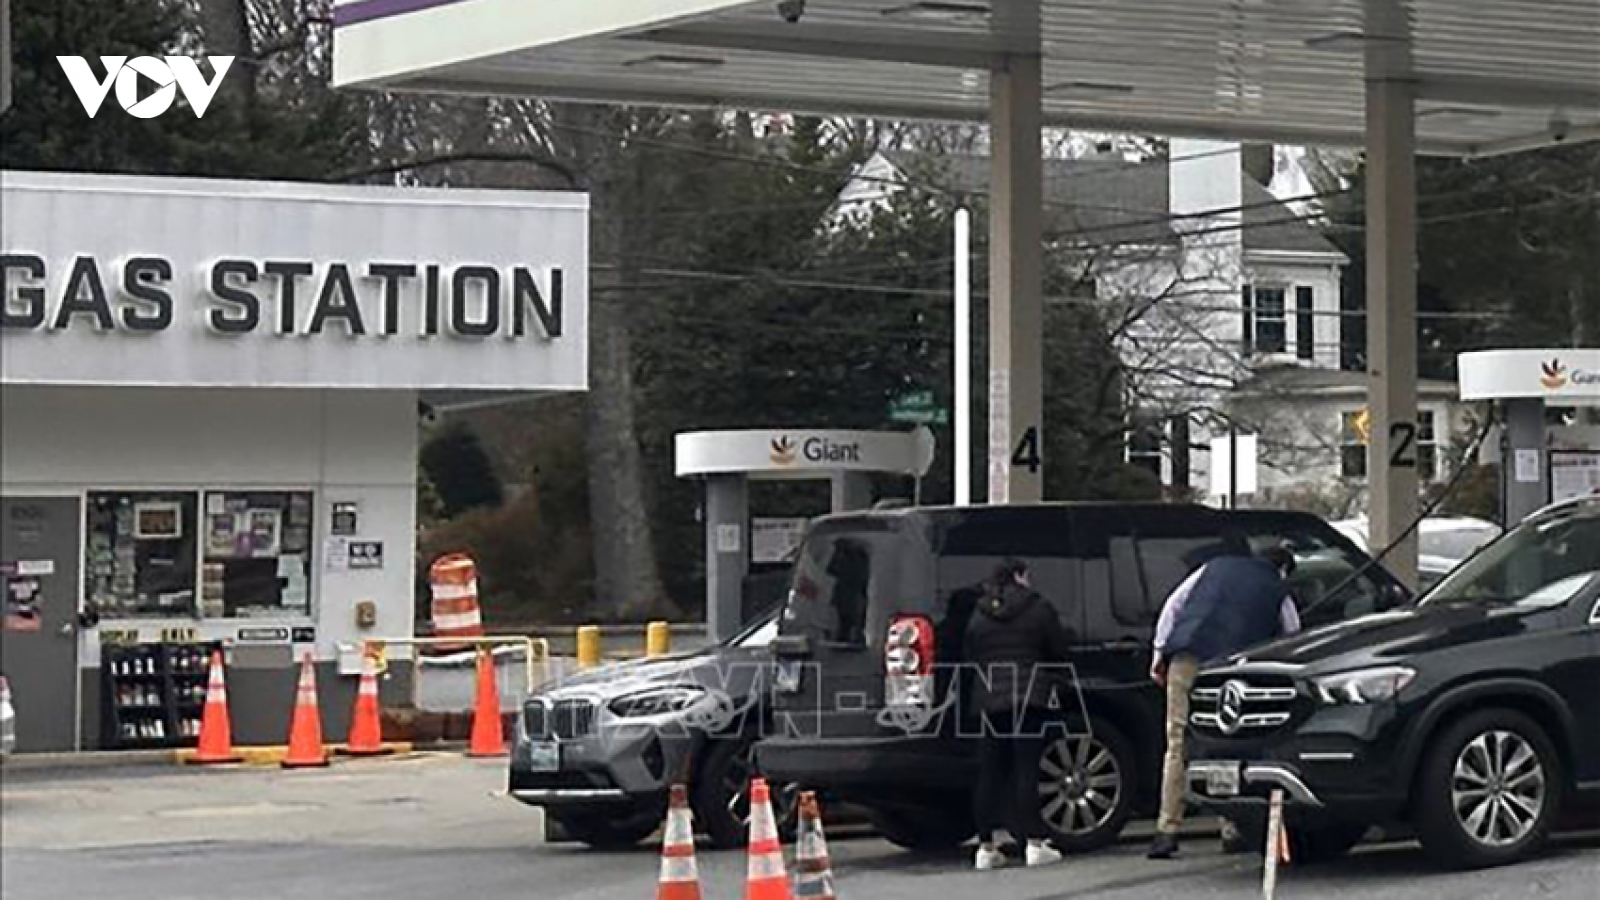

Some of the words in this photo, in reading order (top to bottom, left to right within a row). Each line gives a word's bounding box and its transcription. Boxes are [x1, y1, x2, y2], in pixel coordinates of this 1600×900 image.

[0, 254, 173, 332] GAS
[211, 260, 562, 337] STATION
[803, 437, 860, 462] Giant
[1011, 426, 1041, 473] 4
[1390, 422, 1415, 467] 2
